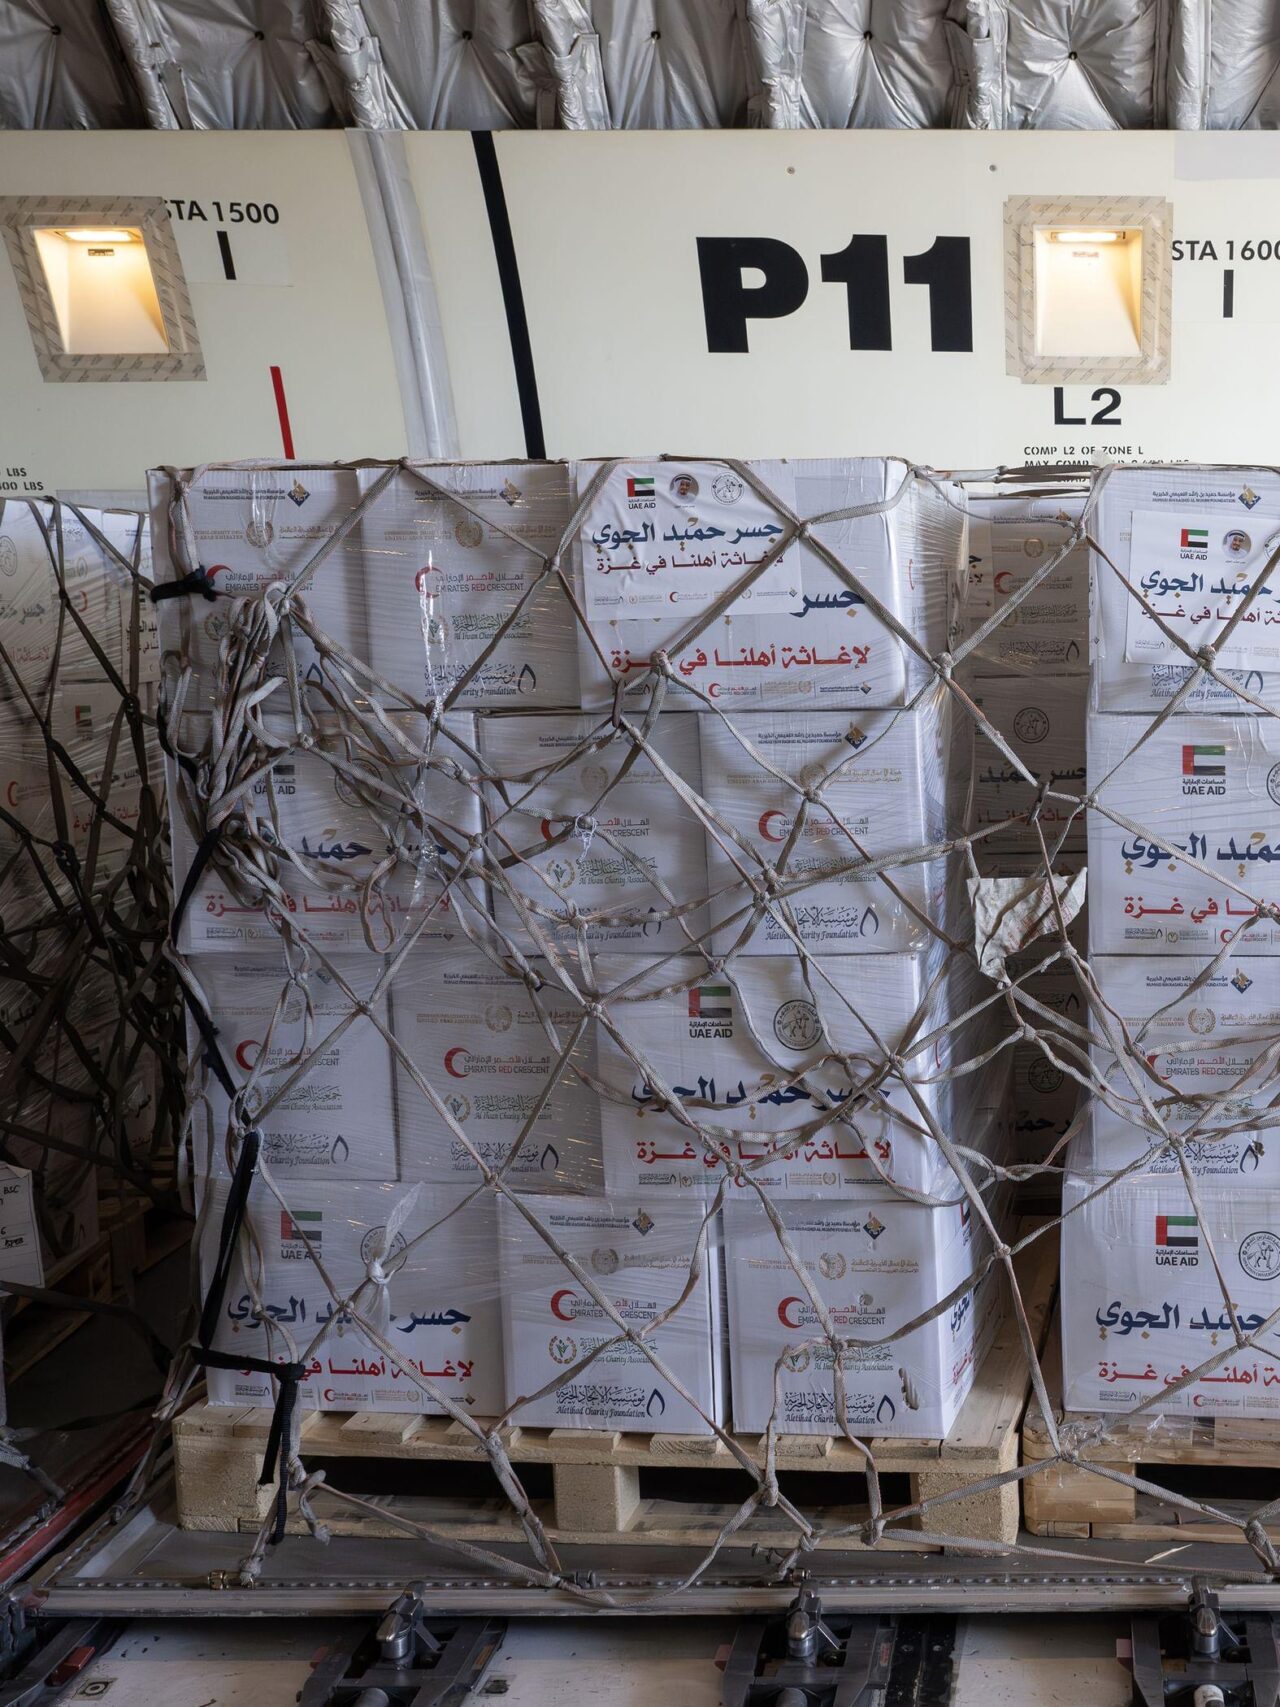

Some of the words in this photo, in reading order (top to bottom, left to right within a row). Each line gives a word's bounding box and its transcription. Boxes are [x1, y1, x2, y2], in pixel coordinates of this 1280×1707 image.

[212, 201, 280, 225] 1500
[1171, 240, 1218, 261] STA
[696, 234, 973, 353] P11
[1054, 387, 1122, 425] L2
[1024, 446, 1057, 456] COMP
[1063, 446, 1075, 456] L2
[1081, 446, 1096, 455] OF
[1102, 446, 1133, 455] ZONE
[6, 467, 28, 477] LBS
[23, 481, 44, 491] LBS
[628, 502, 643, 510] UAE
[643, 502, 657, 510] AID
[592, 520, 656, 554] الجوي
[731, 522, 783, 545] جسر
[596, 557, 641, 574] غزة
[646, 556, 667, 575] في
[671, 551, 718, 568] أهلنا
[1180, 552, 1194, 561] UAE
[1195, 553, 1208, 562] AID
[1140, 569, 1204, 600] الجوي
[790, 590, 867, 618] جسر
[1190, 605, 1212, 625] في
[679, 649, 707, 675] في
[715, 643, 776, 668] أهلنا
[782, 645, 871, 670] لإغاثة
[1182, 785, 1205, 796] UAE
[1206, 785, 1226, 796] AID
[1120, 832, 1207, 876] الجوي
[1124, 896, 1185, 919] غزة
[1190, 896, 1219, 924] في
[689, 1029, 712, 1040] UAE
[713, 1029, 733, 1040] AID
[464, 1065, 497, 1074] EMIRATES
[499, 1065, 513, 1074] RED
[514, 1066, 550, 1074] CRESCENT
[636, 1140, 696, 1164] غزة
[281, 1249, 302, 1260] UAE
[1156, 1256, 1178, 1267] UAE
[1180, 1256, 1198, 1267] AID
[397, 1308, 471, 1335] جسر
[570, 1309, 603, 1318] EMIRATES
[620, 1310, 657, 1320] CRESCENT
[1096, 1301, 1179, 1341] الجوي
[329, 1355, 385, 1377] أهلنا
[1098, 1361, 1158, 1384] غزة
[556, 1406, 583, 1416] Aletihad
[584, 1406, 608, 1418] Charity
[608, 1406, 646, 1419] Foundation
